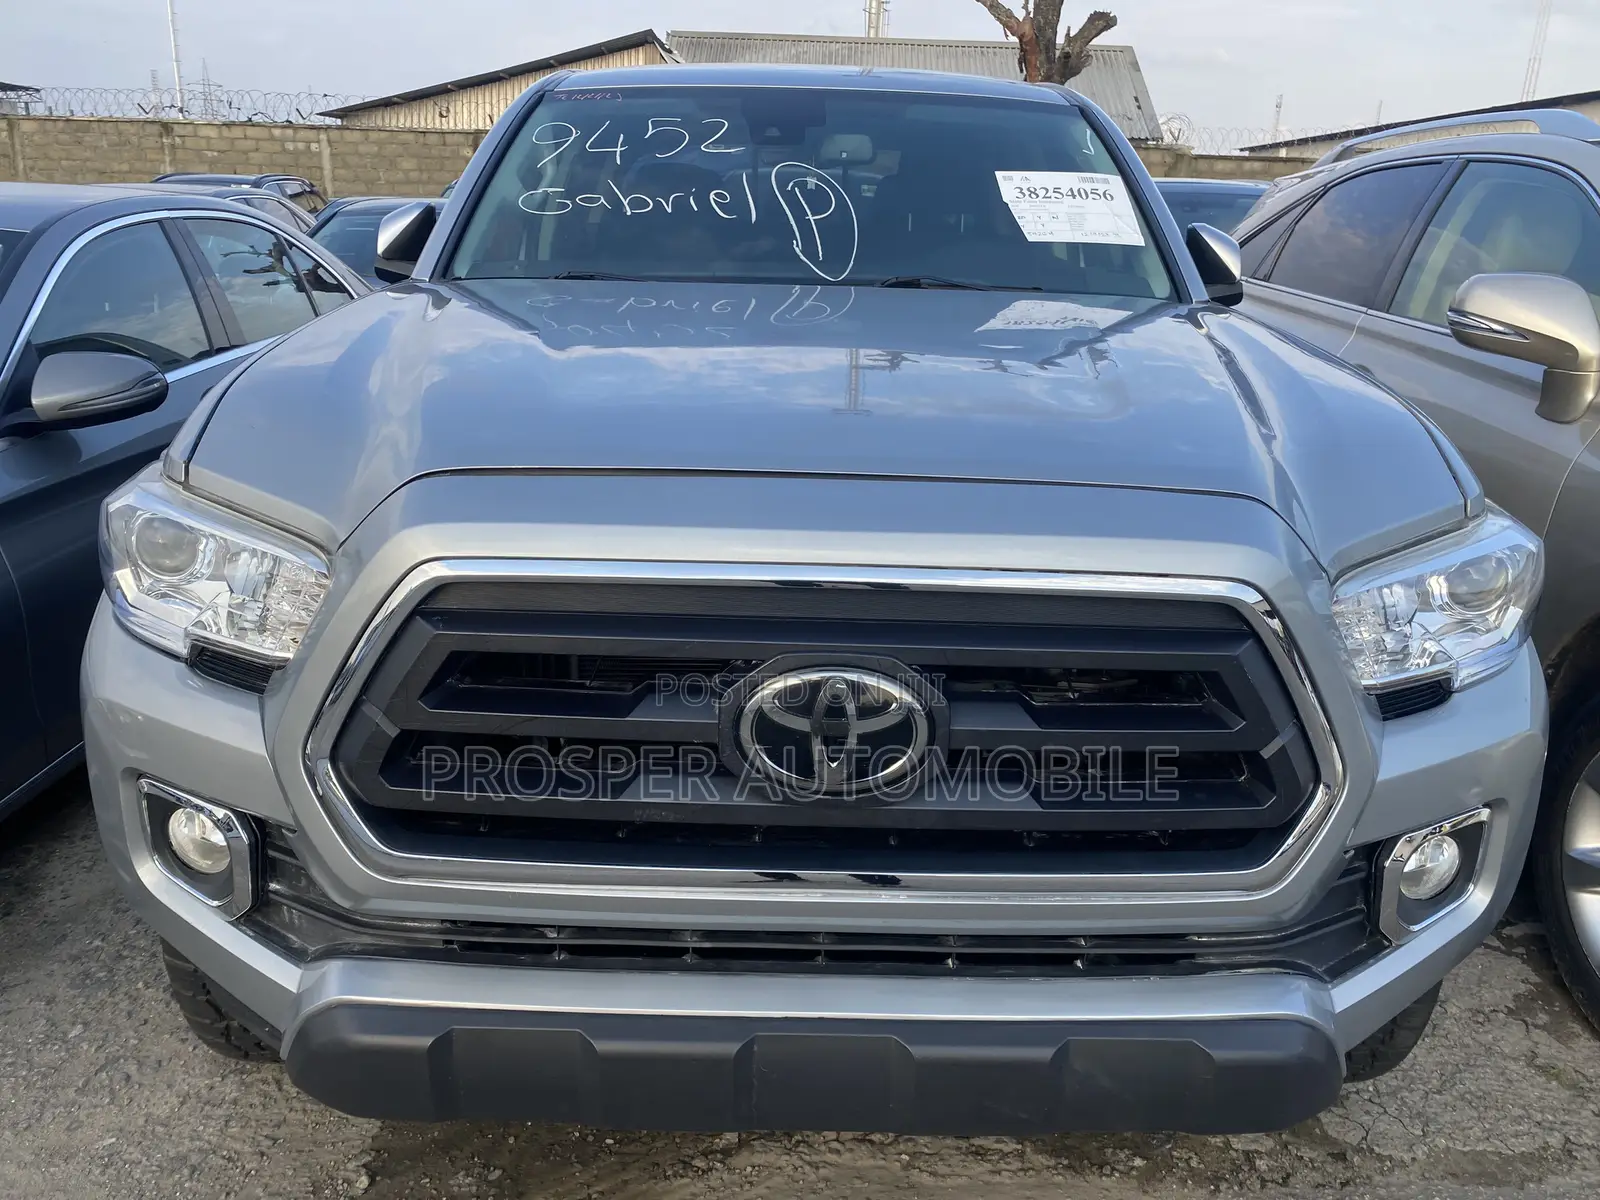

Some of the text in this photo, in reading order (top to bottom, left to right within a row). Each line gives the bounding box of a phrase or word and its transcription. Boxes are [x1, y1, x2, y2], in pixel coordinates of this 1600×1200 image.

[532, 117, 746, 169] 9452
[518, 171, 757, 224] Gabriel
[1013, 186, 1115, 202] 38254056
